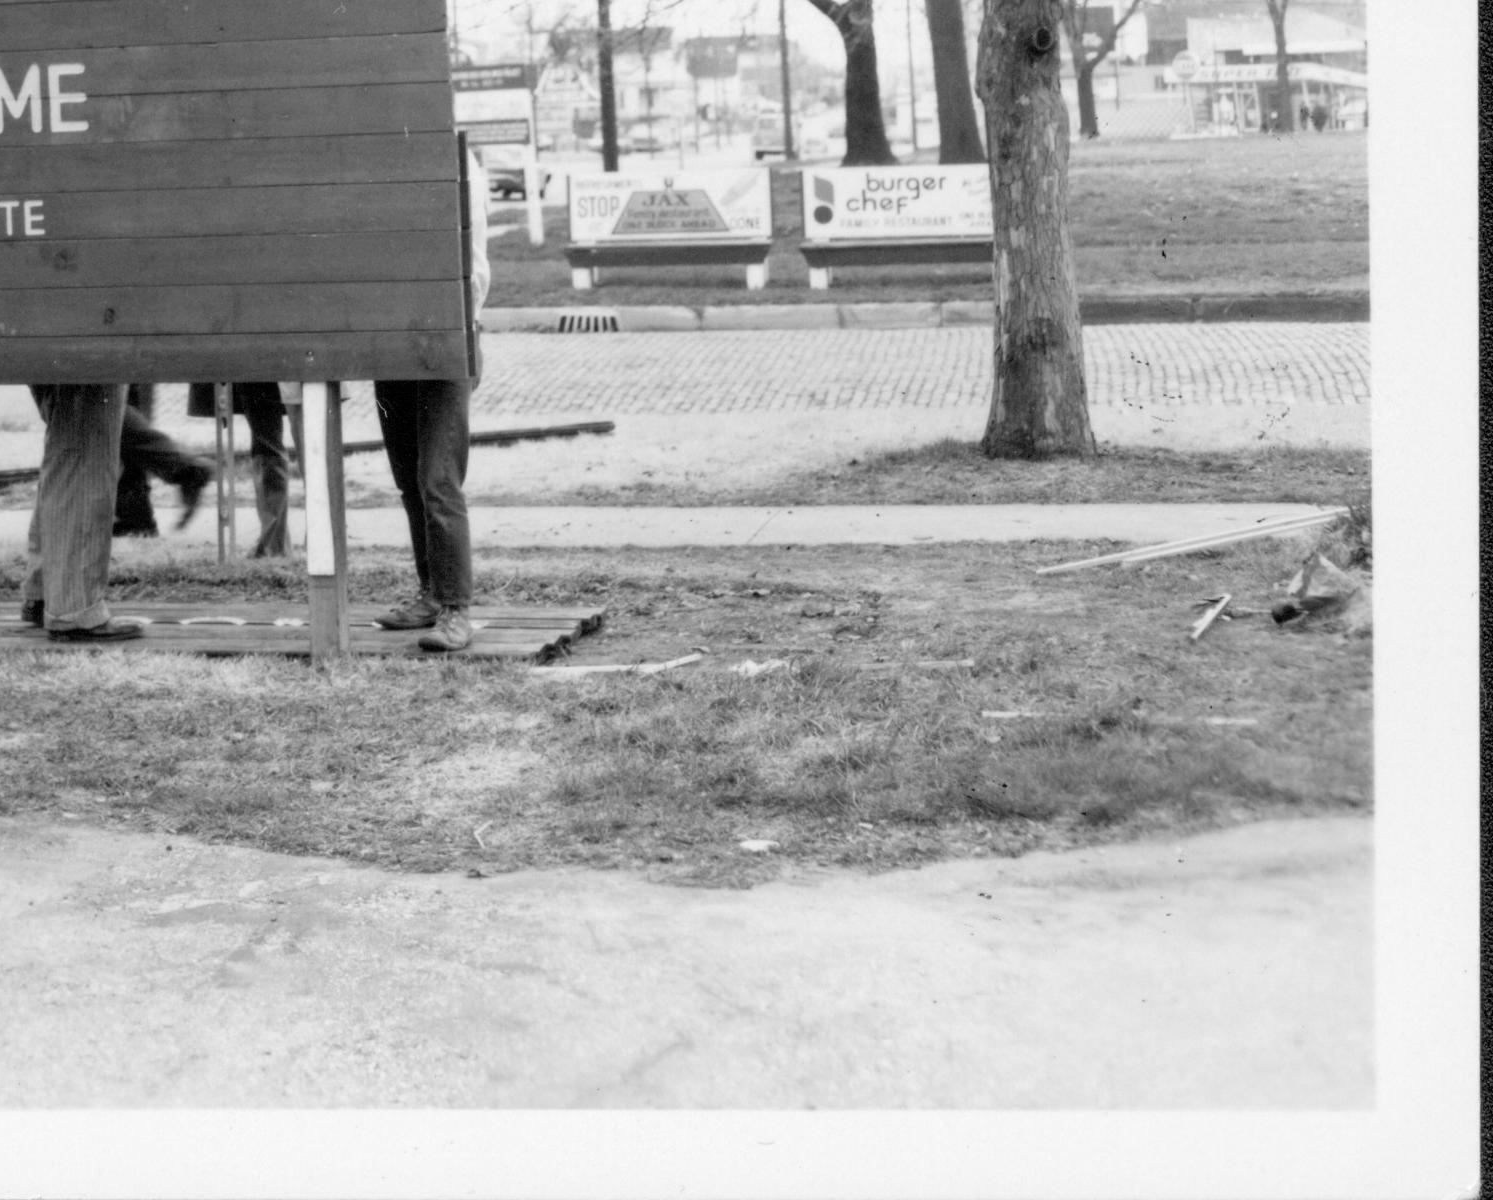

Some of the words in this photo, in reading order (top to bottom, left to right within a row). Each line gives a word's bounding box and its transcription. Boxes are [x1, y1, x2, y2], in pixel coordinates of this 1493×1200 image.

[866, 172, 947, 200] burger
[577, 195, 620, 218] STOP
[642, 193, 690, 207] JAX
[846, 189, 909, 214] chef
